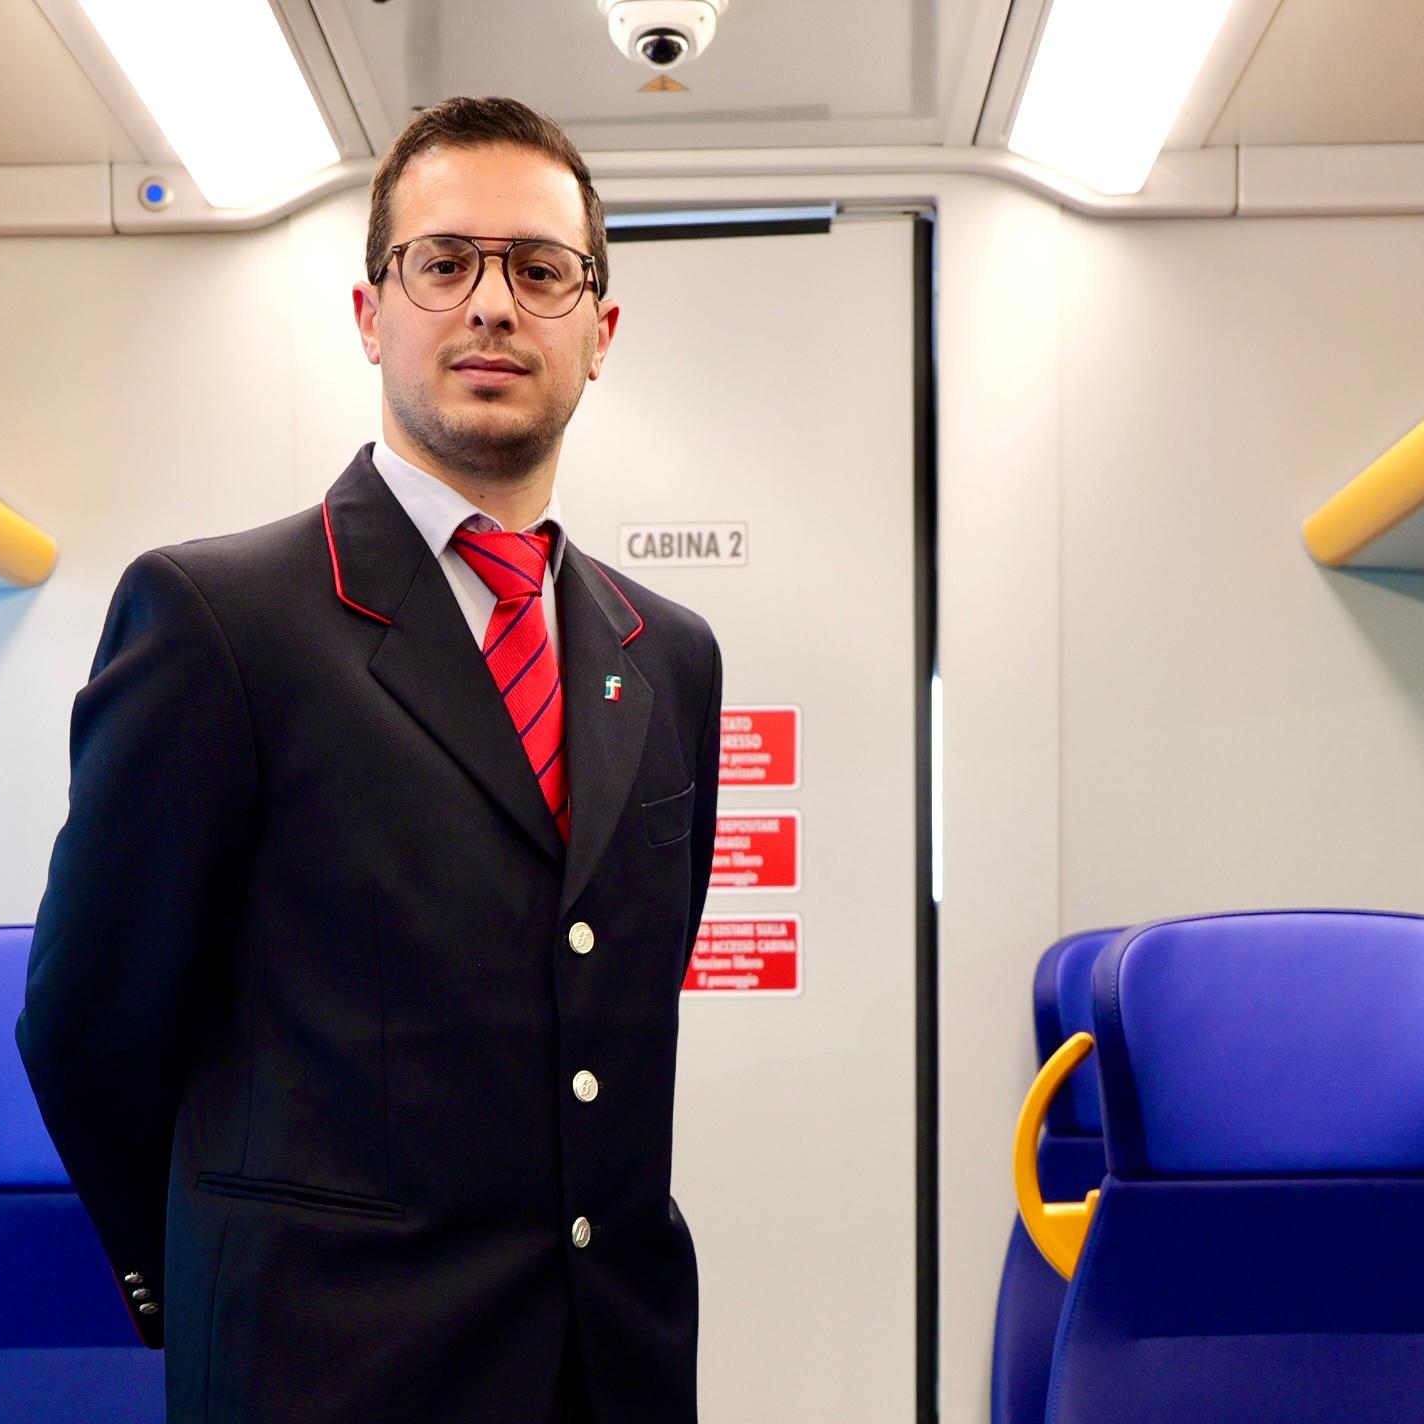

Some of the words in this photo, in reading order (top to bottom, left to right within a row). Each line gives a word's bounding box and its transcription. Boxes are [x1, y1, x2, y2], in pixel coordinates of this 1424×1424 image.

[627, 531, 720, 559] CABINA
[728, 530, 742, 558] 2
[756, 939, 797, 953] CABINA
